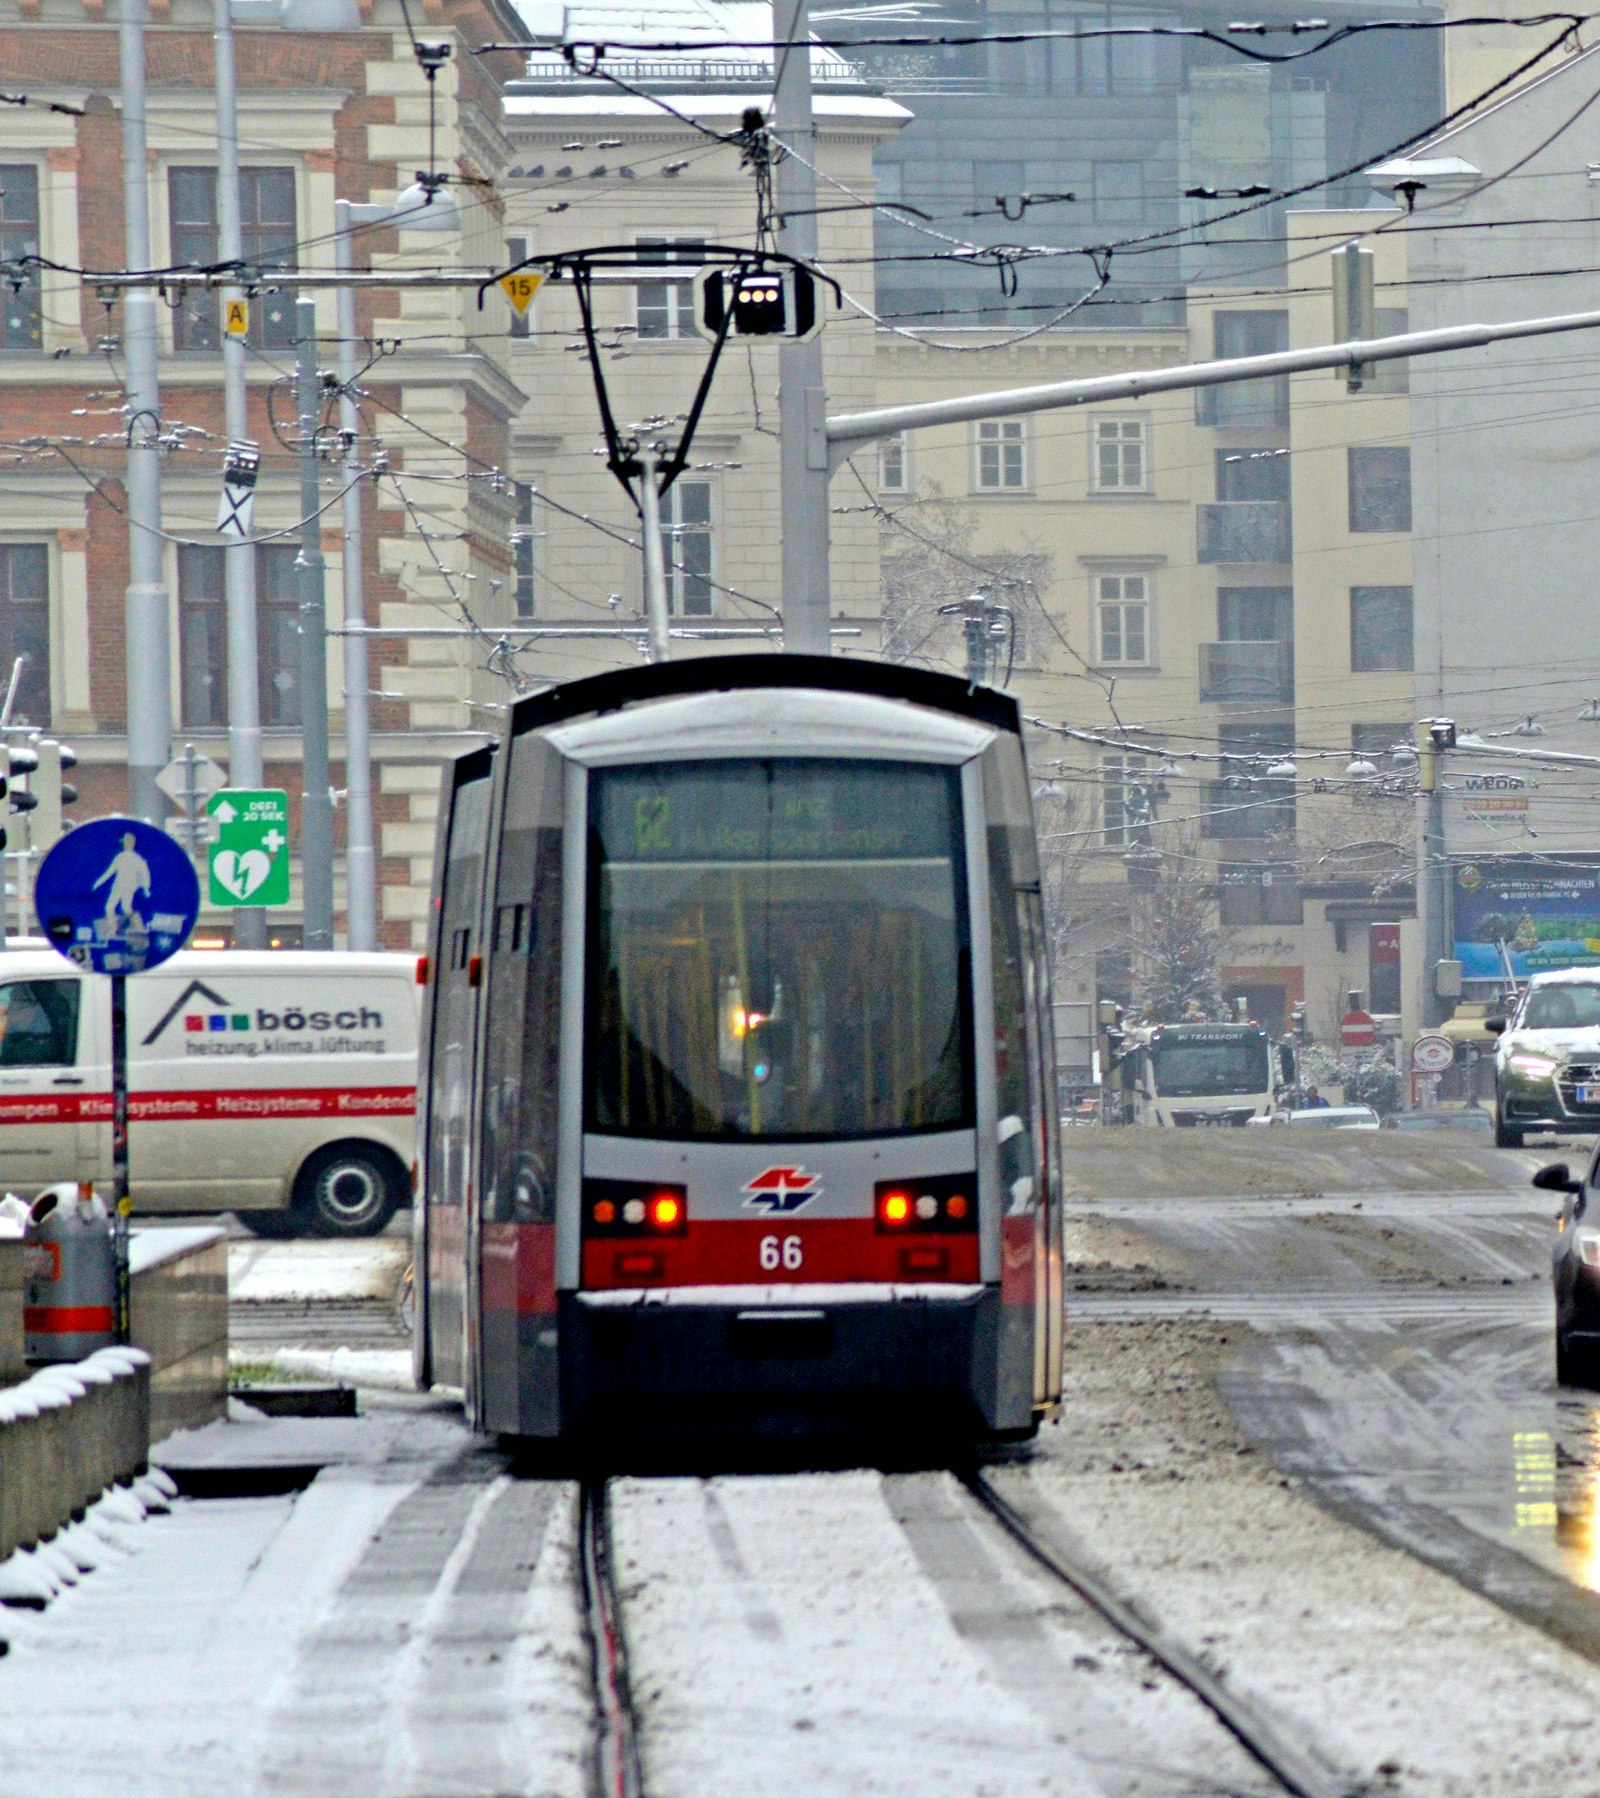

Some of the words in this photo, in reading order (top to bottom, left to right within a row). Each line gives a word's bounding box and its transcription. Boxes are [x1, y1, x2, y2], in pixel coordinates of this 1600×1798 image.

[509, 279, 531, 296] 15
[229, 305, 243, 323] A
[249, 801, 277, 811] DEFI
[242, 811, 258, 821] 20
[260, 811, 285, 821] SEK
[256, 1007, 383, 1031] bösch
[79, 1097, 198, 1118] Klimsysteme
[216, 1096, 320, 1114] Heizsysteme
[760, 1235, 802, 1270] 66
